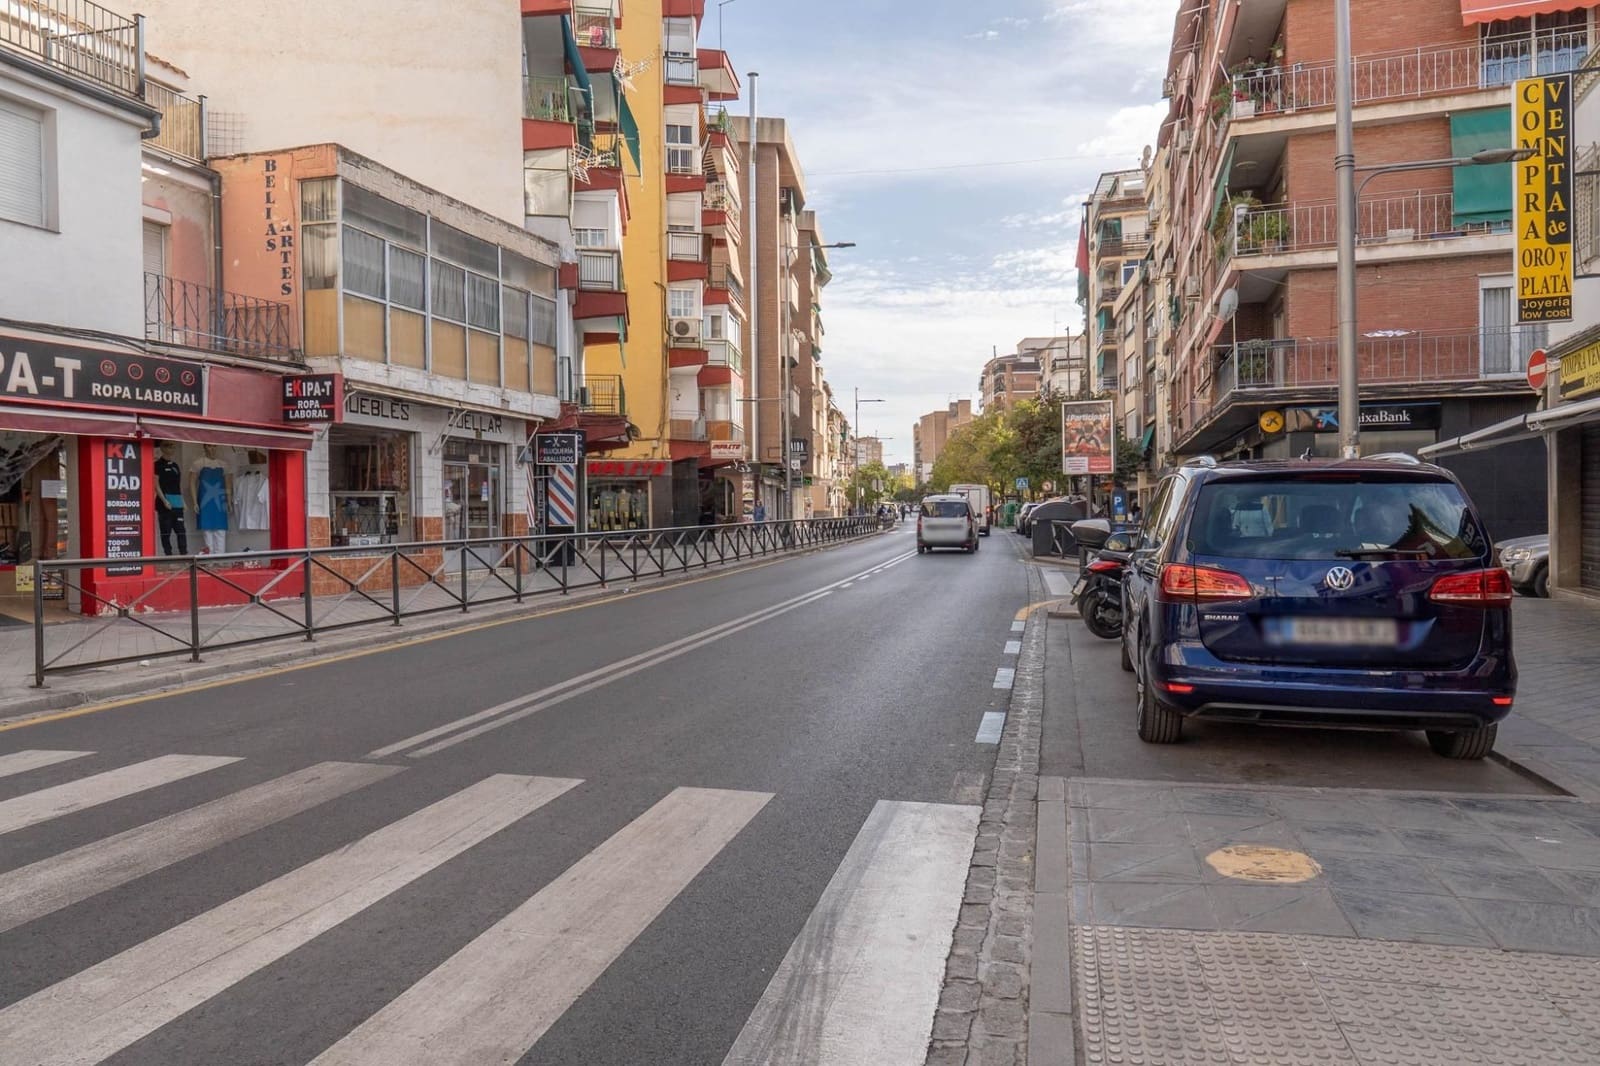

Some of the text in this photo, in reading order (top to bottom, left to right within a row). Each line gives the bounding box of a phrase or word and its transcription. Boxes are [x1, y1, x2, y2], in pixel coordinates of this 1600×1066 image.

[1546, 81, 1566, 213] VENTA
[1520, 83, 1543, 240] COMPRA
[1548, 220, 1567, 236] de
[1522, 247, 1555, 267] ORO
[1521, 274, 1570, 296] PLATA
[1522, 297, 1570, 310] Joyería
[1522, 308, 1570, 319] low cost
[0, 351, 199, 406] A-T ROPA LABORAL
[285, 380, 332, 397] EKIPA-T
[297, 400, 320, 409] ROPA
[289, 409, 328, 419] LABORAL
[1359, 410, 1411, 423] ixaBank
[107, 443, 136, 459] KA
[107, 459, 124, 474] LI
[107, 475, 141, 490] DAD
[1114, 497, 1122, 505] P
[107, 513, 141, 522] SERIGRAFÍA
